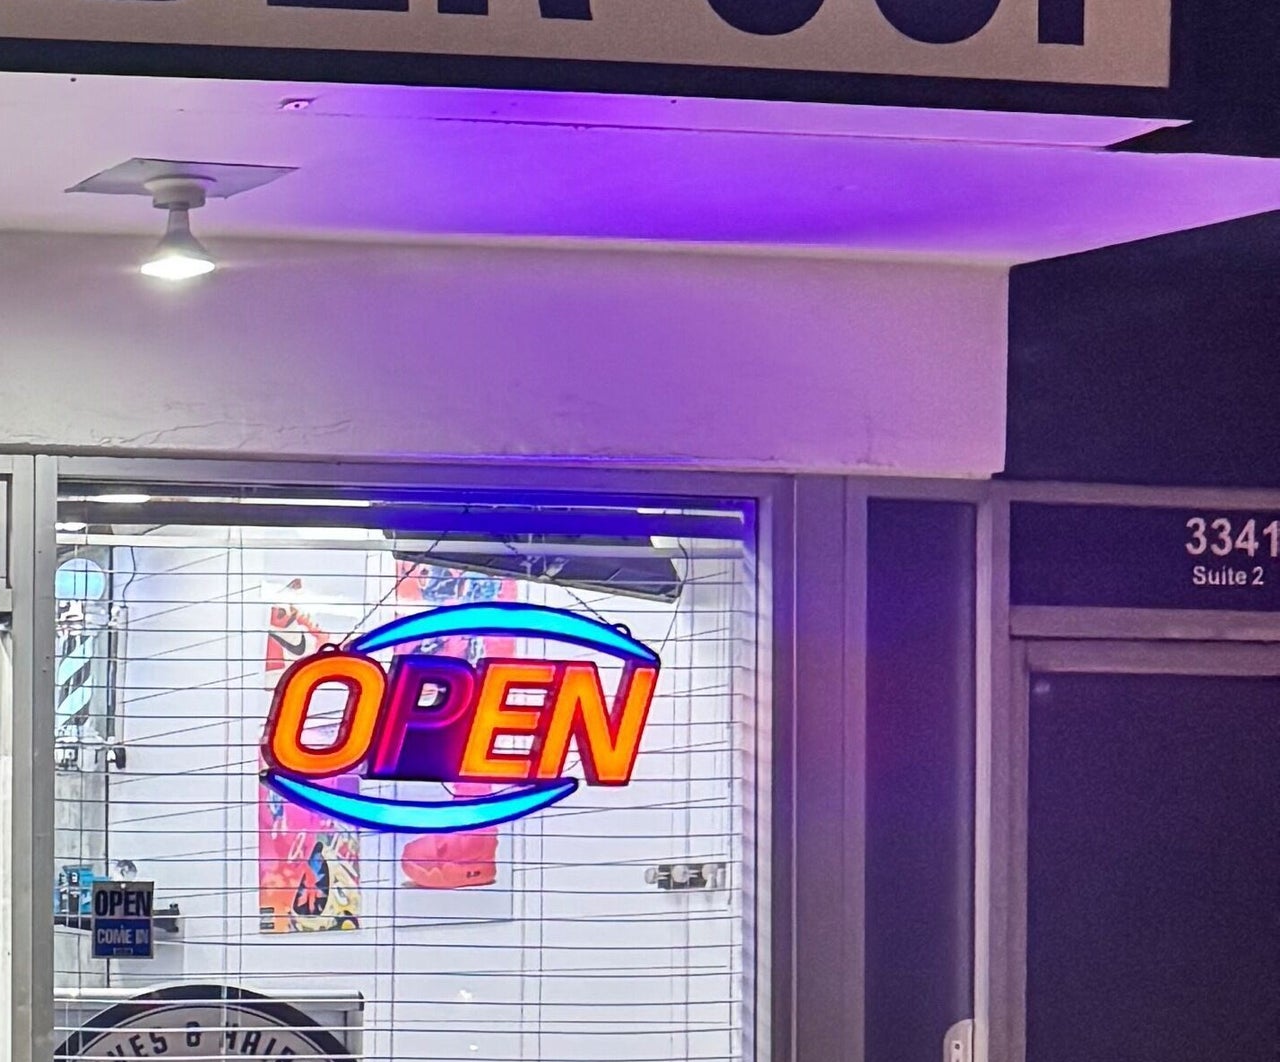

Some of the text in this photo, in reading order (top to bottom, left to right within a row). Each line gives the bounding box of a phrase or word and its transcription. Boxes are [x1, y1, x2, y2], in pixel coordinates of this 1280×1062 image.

[1185, 517, 1279, 557] 3341
[1192, 565, 1265, 586] Suite 2
[262, 654, 660, 786] OPEN
[94, 890, 152, 917] OPEN
[96, 928, 133, 944] COME
